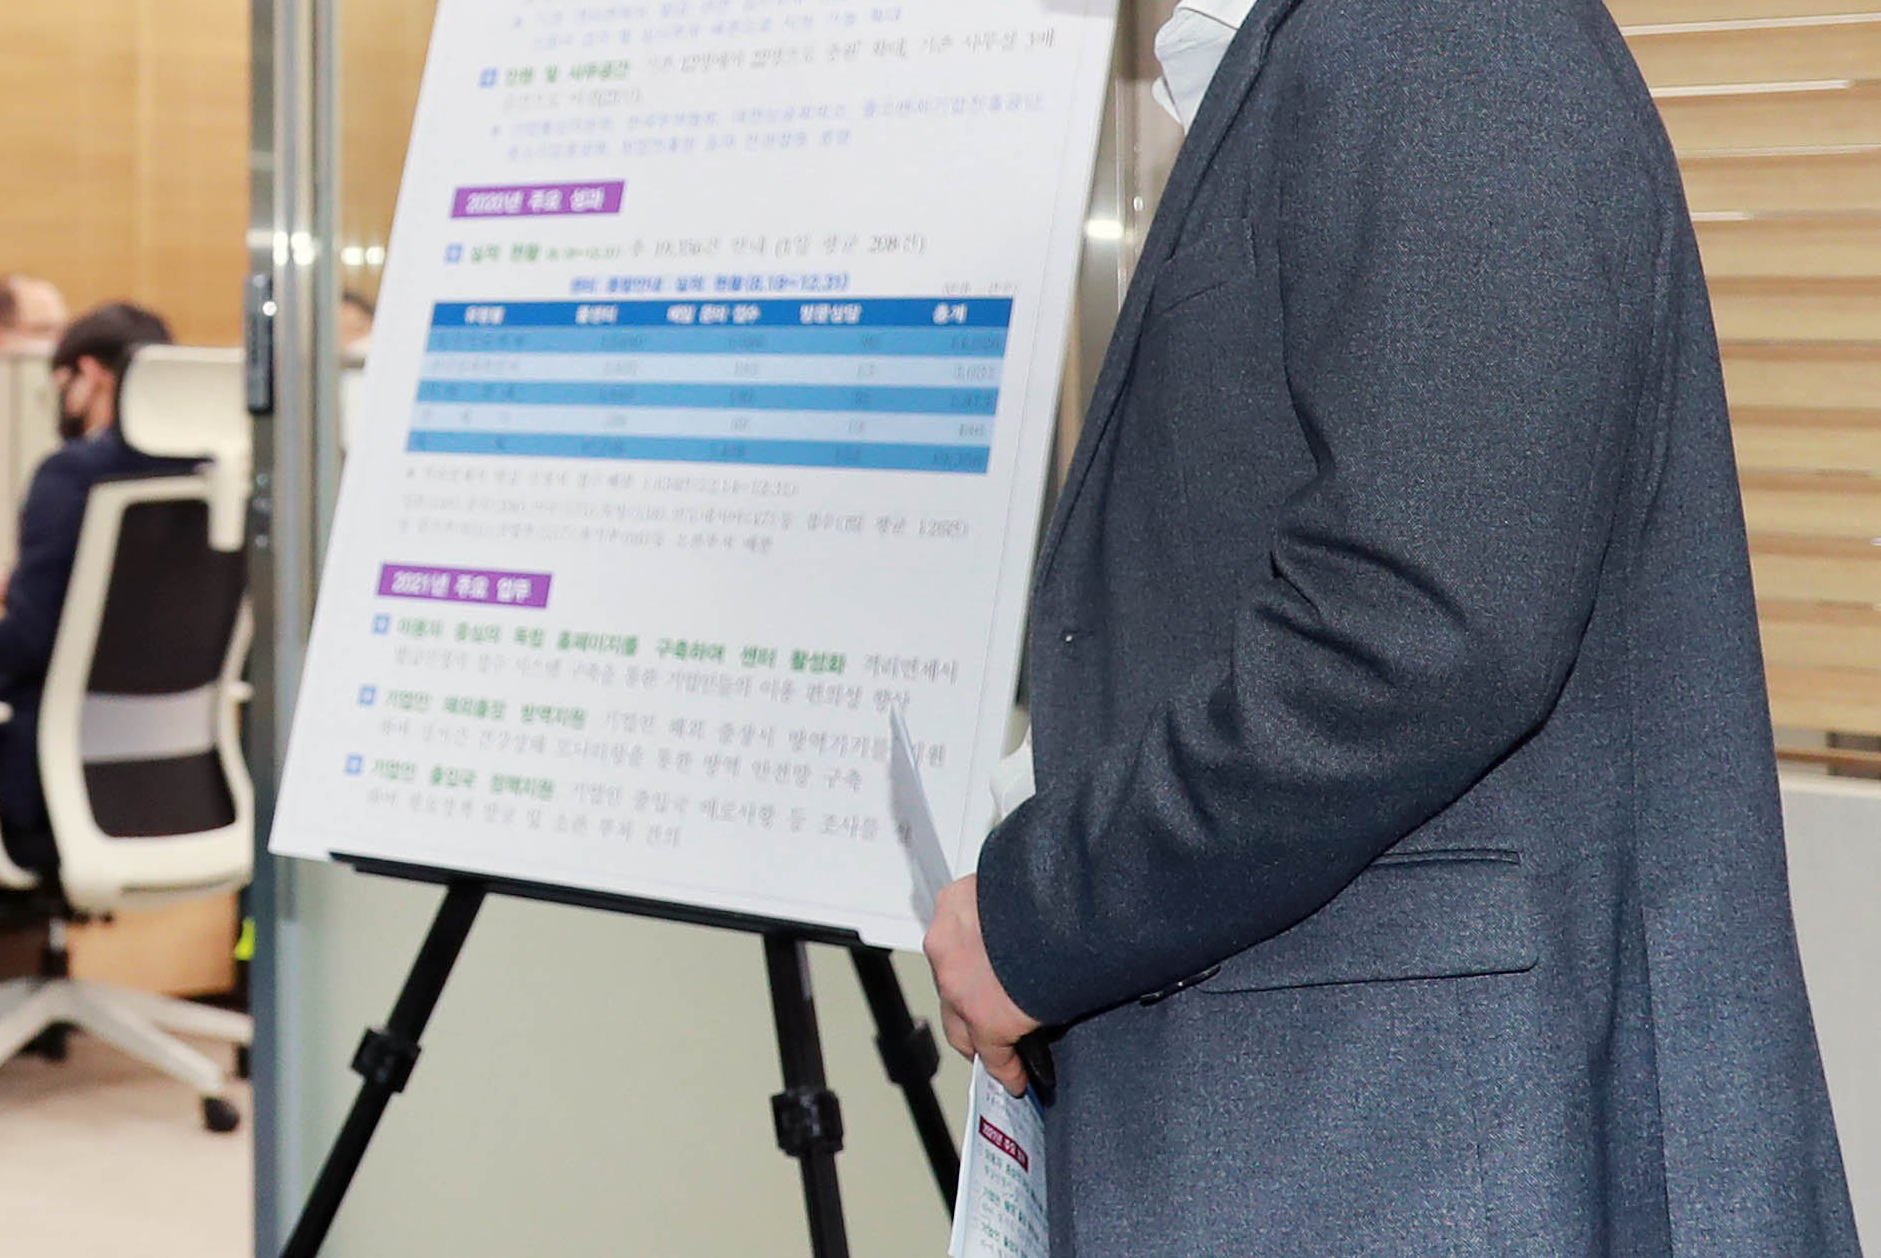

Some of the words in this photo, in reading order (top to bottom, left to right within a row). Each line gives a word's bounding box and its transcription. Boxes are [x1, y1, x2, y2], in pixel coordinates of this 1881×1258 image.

[528, 189, 562, 213] 주요
[389, 570, 452, 598] 2021년
[454, 572, 491, 600] 주요
[495, 575, 533, 604] 업무
[557, 629, 639, 657] 홈페이지를
[656, 637, 726, 664] 구축하여
[740, 644, 778, 669] 센터
[790, 647, 847, 675] 활성화
